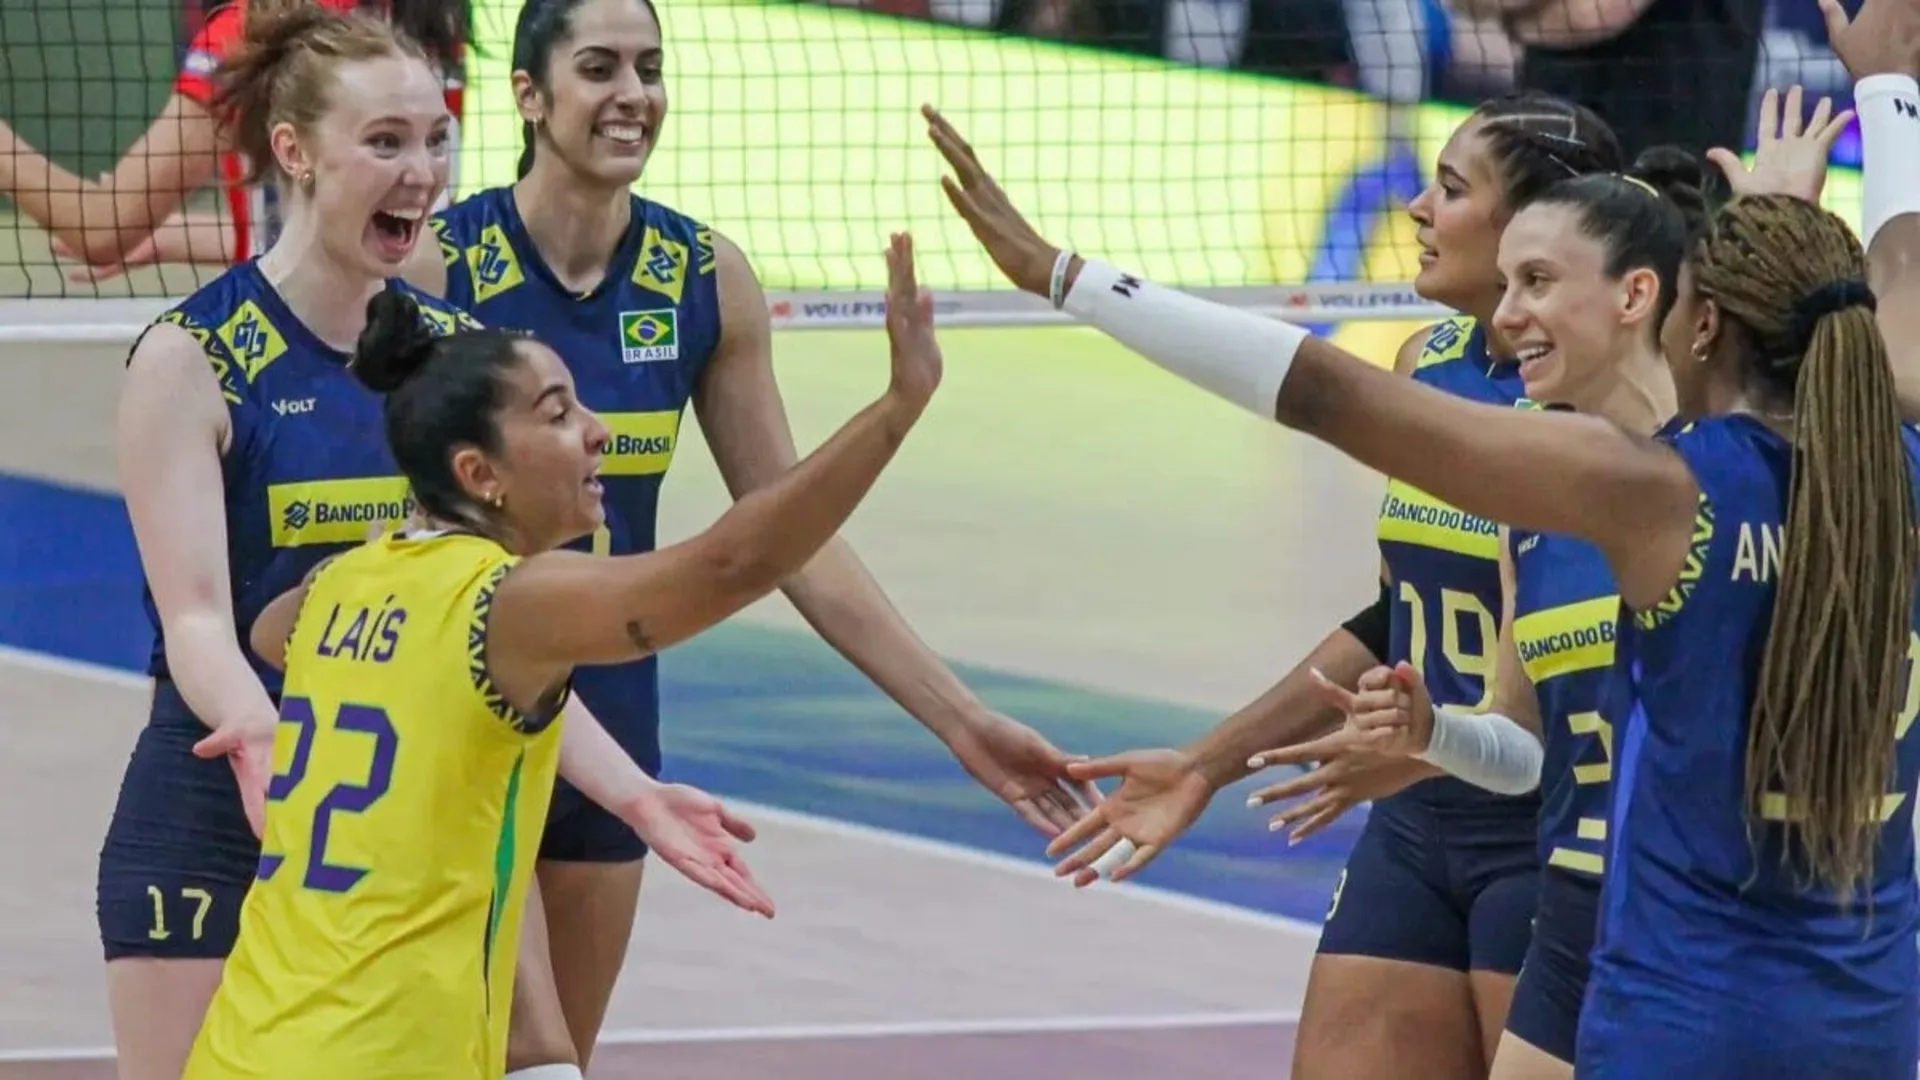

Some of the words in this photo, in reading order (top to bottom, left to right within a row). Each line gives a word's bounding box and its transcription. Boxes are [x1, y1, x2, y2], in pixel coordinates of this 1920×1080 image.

[626, 347, 676, 361] BRASIL
[271, 398, 316, 416] VOLT
[315, 502, 375, 524] BANCO
[1388, 497, 1438, 525] BANCO
[317, 593, 407, 663] LAÍS
[1400, 581, 1498, 716] 19
[1520, 632, 1572, 662] BANCO
[257, 695, 399, 893] 22
[147, 885, 212, 940] 17
